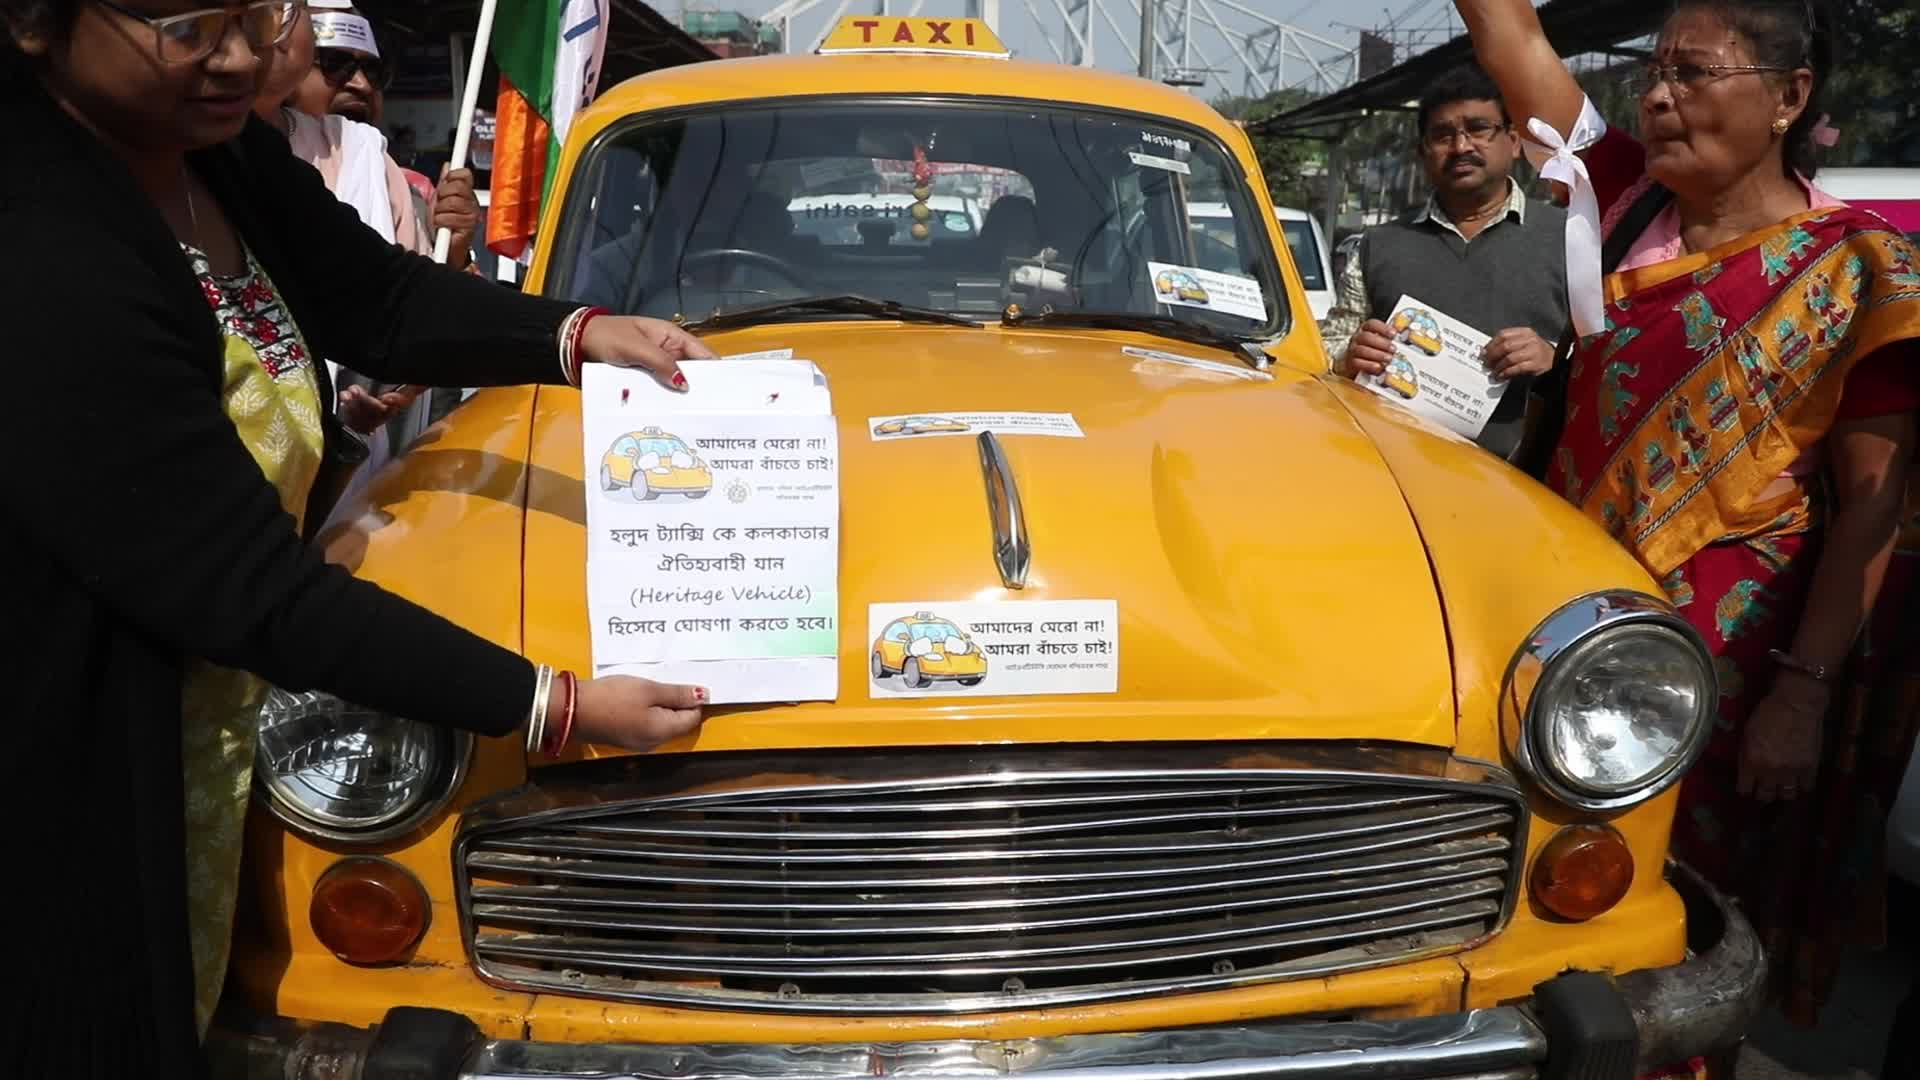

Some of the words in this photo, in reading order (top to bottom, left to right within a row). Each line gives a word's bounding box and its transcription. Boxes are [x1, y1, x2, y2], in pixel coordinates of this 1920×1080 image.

[854, 21, 974, 45] TAXI
[696, 438, 756, 450] আমাদের
[764, 439, 800, 449] মেরো
[807, 438, 826, 449] না!
[711, 459, 753, 471] আমরা
[760, 456, 800, 470] বাঁচতে
[807, 456, 833, 470] চাই!
[610, 529, 648, 547] হলুদ
[657, 523, 704, 541] ট্যাক্সি
[713, 528, 736, 540] কে
[744, 527, 830, 540] কলকাতার
[657, 553, 746, 572] ঐতিহ্যবাহী
[754, 558, 784, 570] যান
[631, 587, 724, 608] (Heritage
[732, 585, 811, 608] Vehicle)
[608, 616, 666, 635] হিসেবে
[675, 618, 731, 632] ঘোষণা
[739, 618, 789, 631] করতে
[796, 617, 832, 630] হবে।
[970, 622, 1032, 635] আমাদের
[1040, 621, 1078, 633] মেরো
[1084, 620, 1104, 632] না!
[985, 644, 1030, 655] আমরা
[1037, 640, 1078, 654] বাঁচতে
[1084, 640, 1112, 654] চাই!
